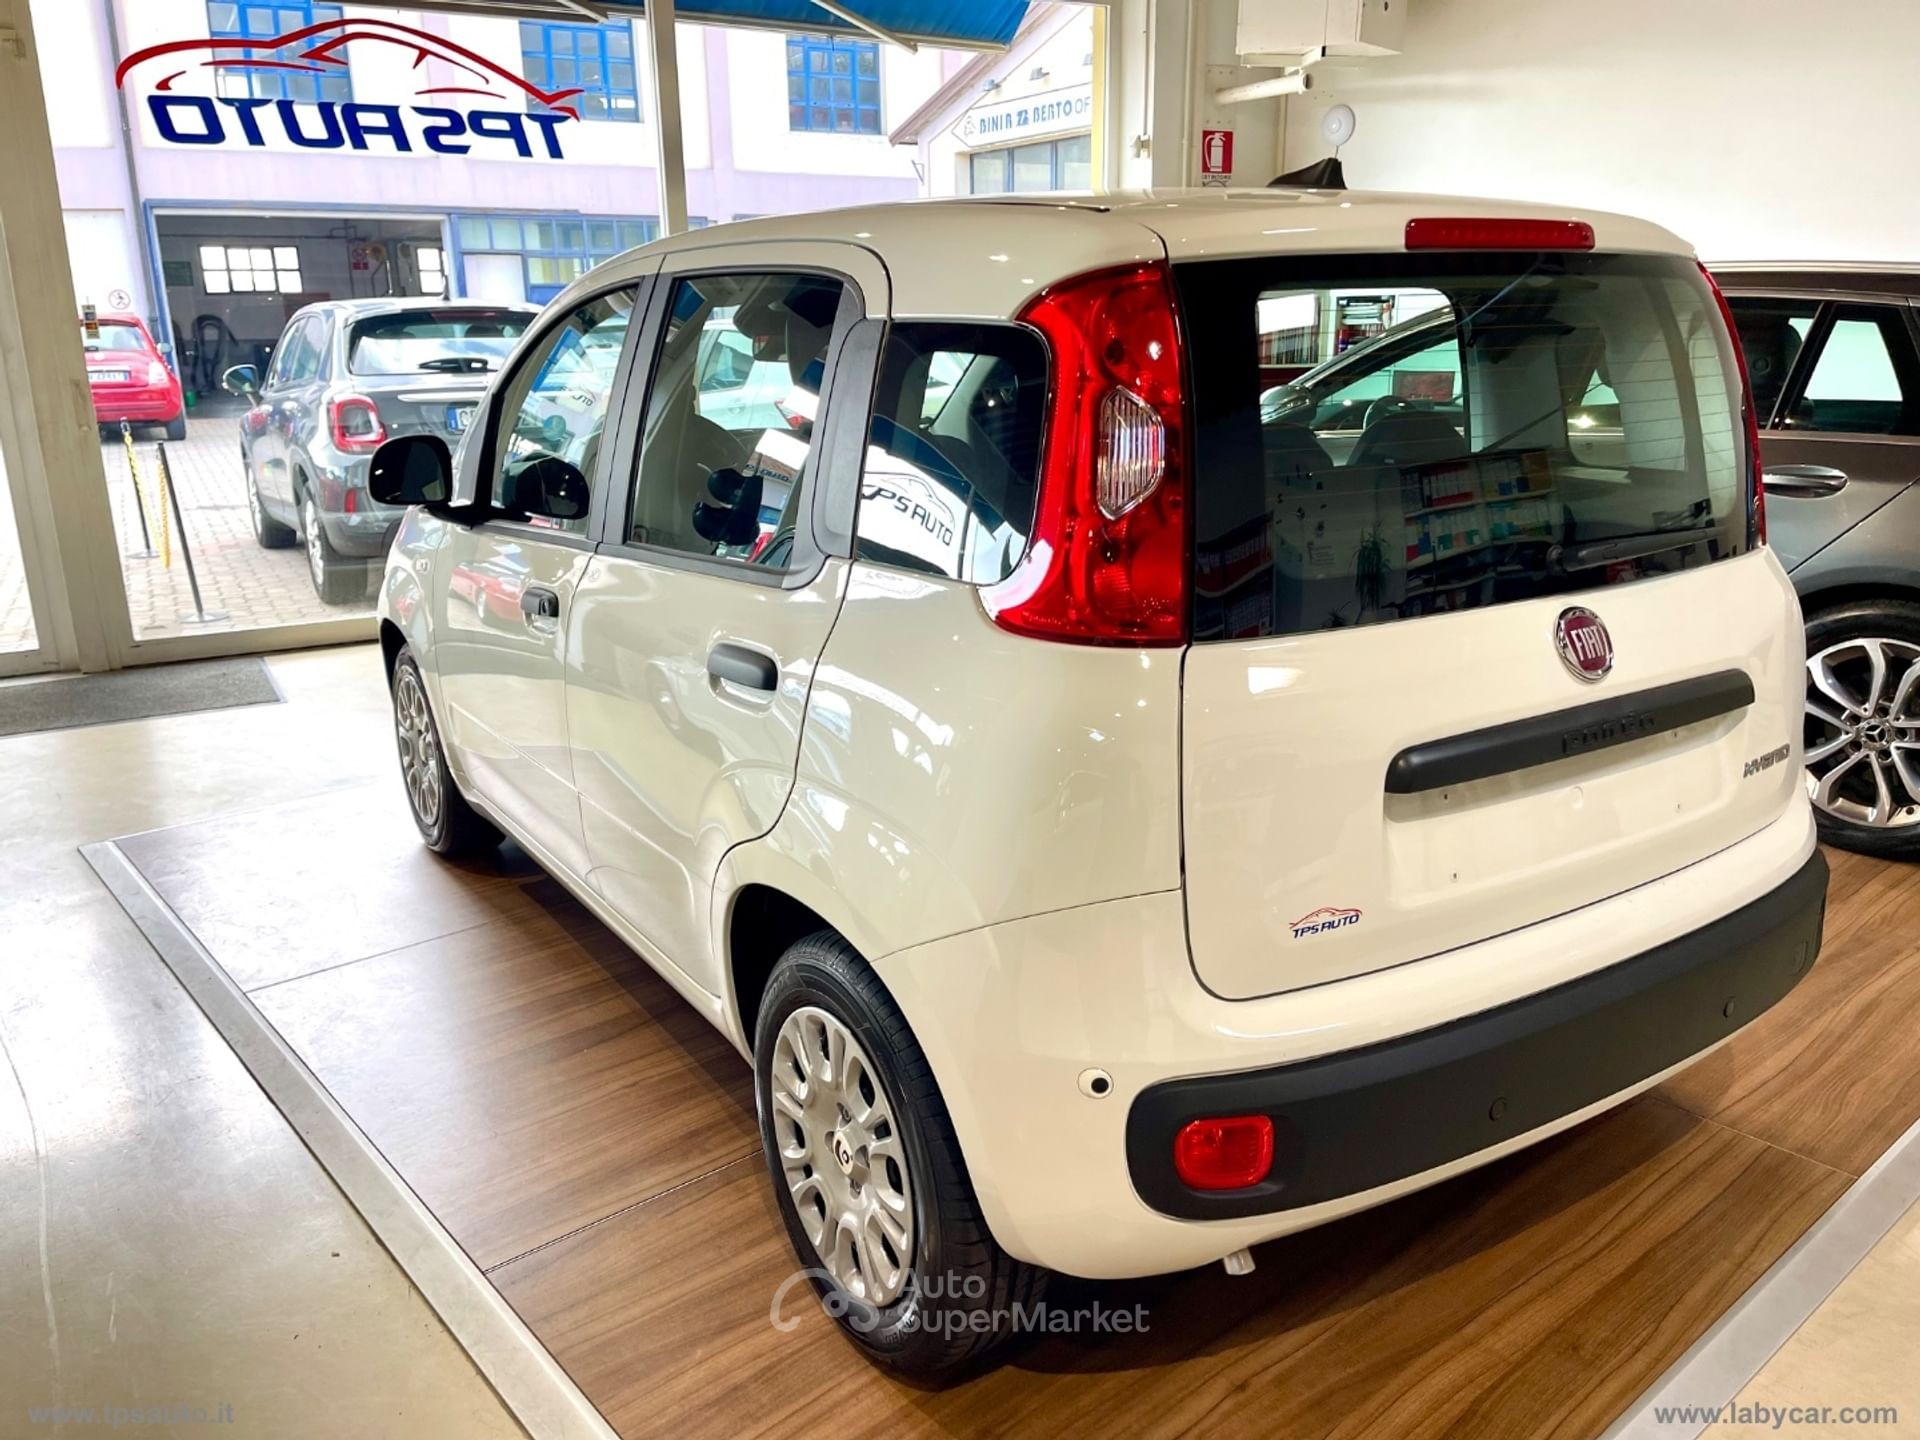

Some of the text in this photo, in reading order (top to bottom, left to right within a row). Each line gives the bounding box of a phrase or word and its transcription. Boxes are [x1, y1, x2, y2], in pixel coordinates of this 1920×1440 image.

[911, 503, 954, 547] AUTO
[1570, 624, 1606, 661] FIAT
[1292, 913, 1360, 939] TPS AUTO
